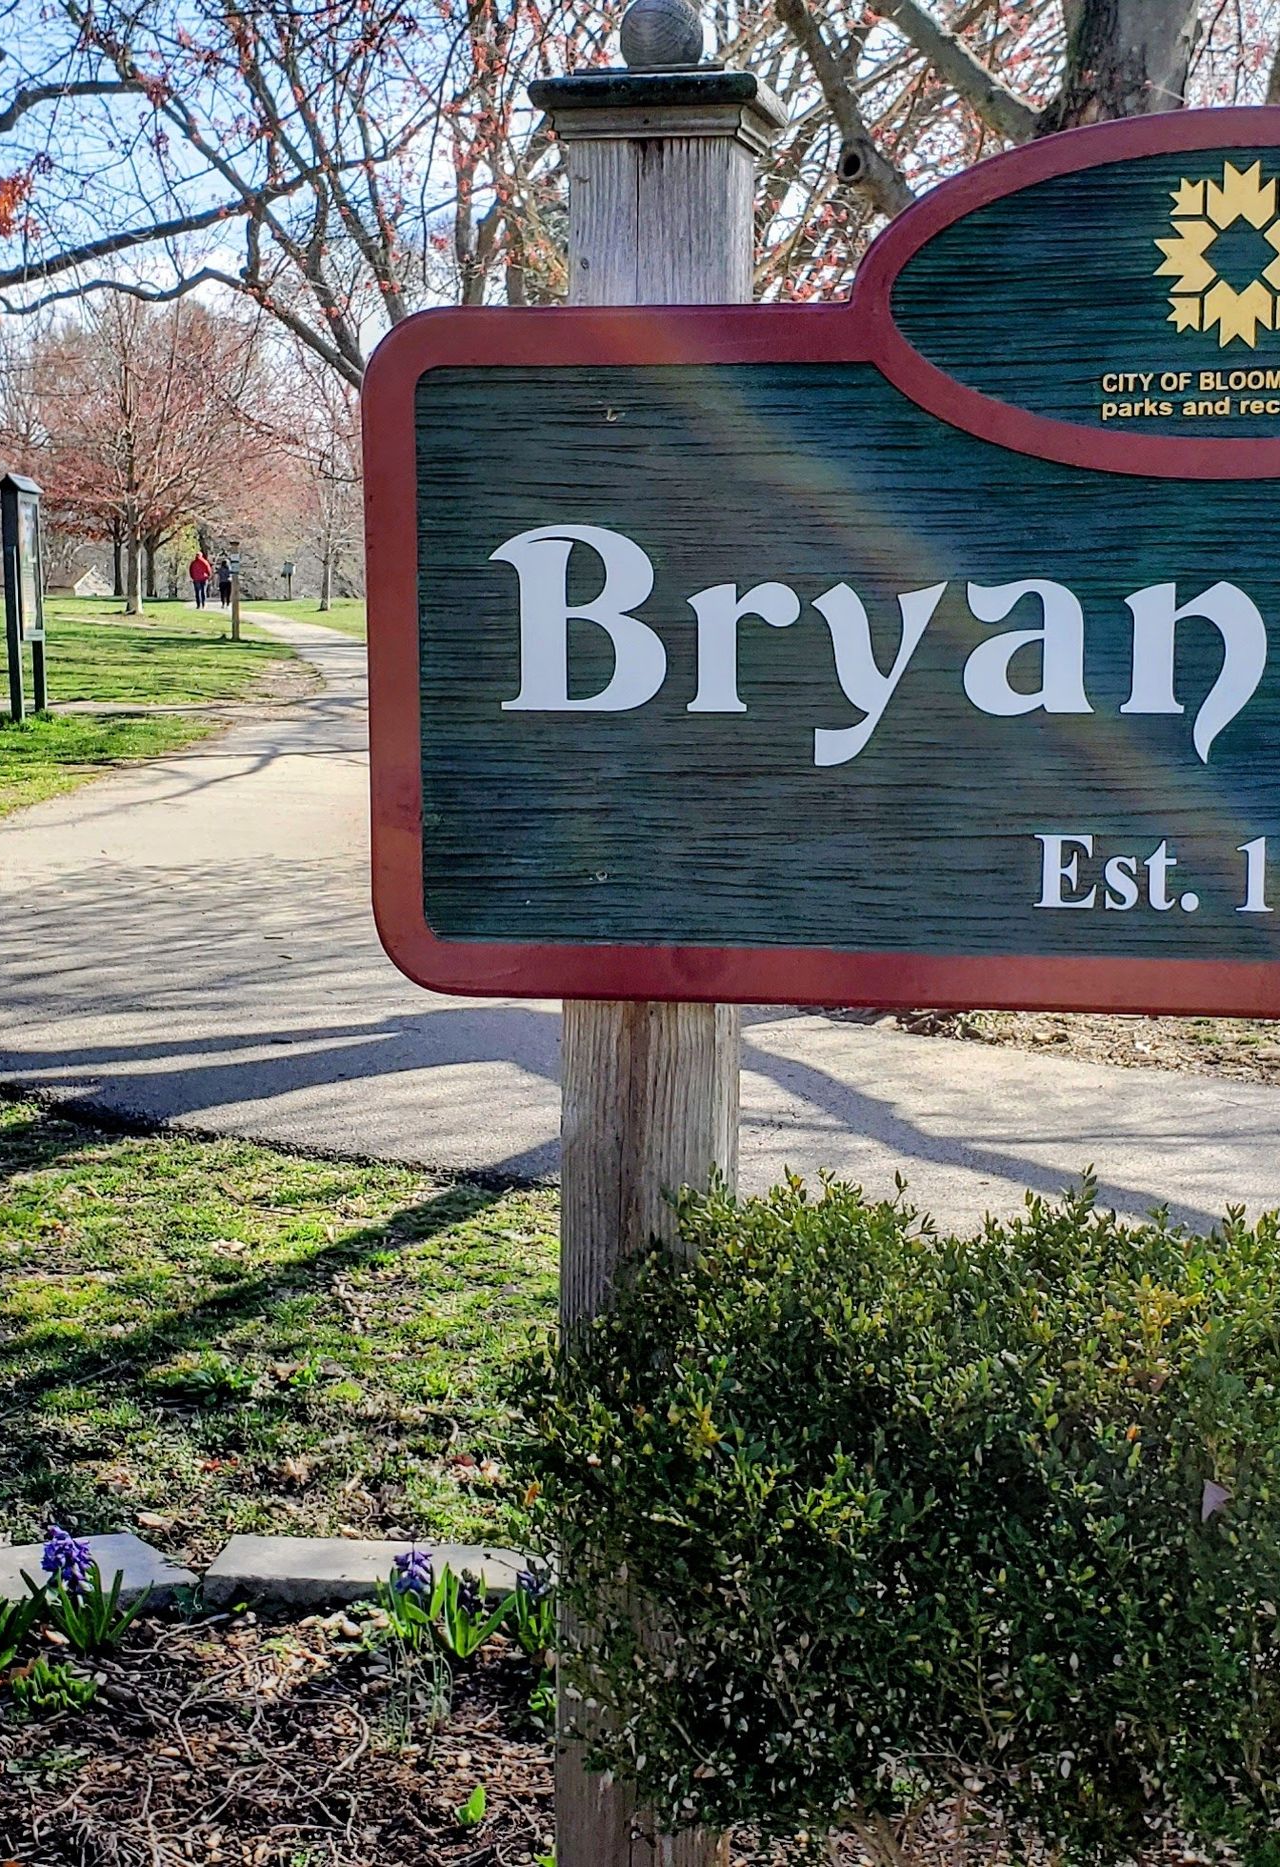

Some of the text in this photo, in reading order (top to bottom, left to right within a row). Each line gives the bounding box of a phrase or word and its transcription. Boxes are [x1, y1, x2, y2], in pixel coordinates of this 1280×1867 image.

[1102, 373, 1154, 392] CITY
[1160, 371, 1192, 391] OF
[1102, 398, 1174, 420] parks
[1182, 396, 1230, 416] and
[488, 524, 1268, 767] Bryan
[1033, 834, 1199, 912] Est.
